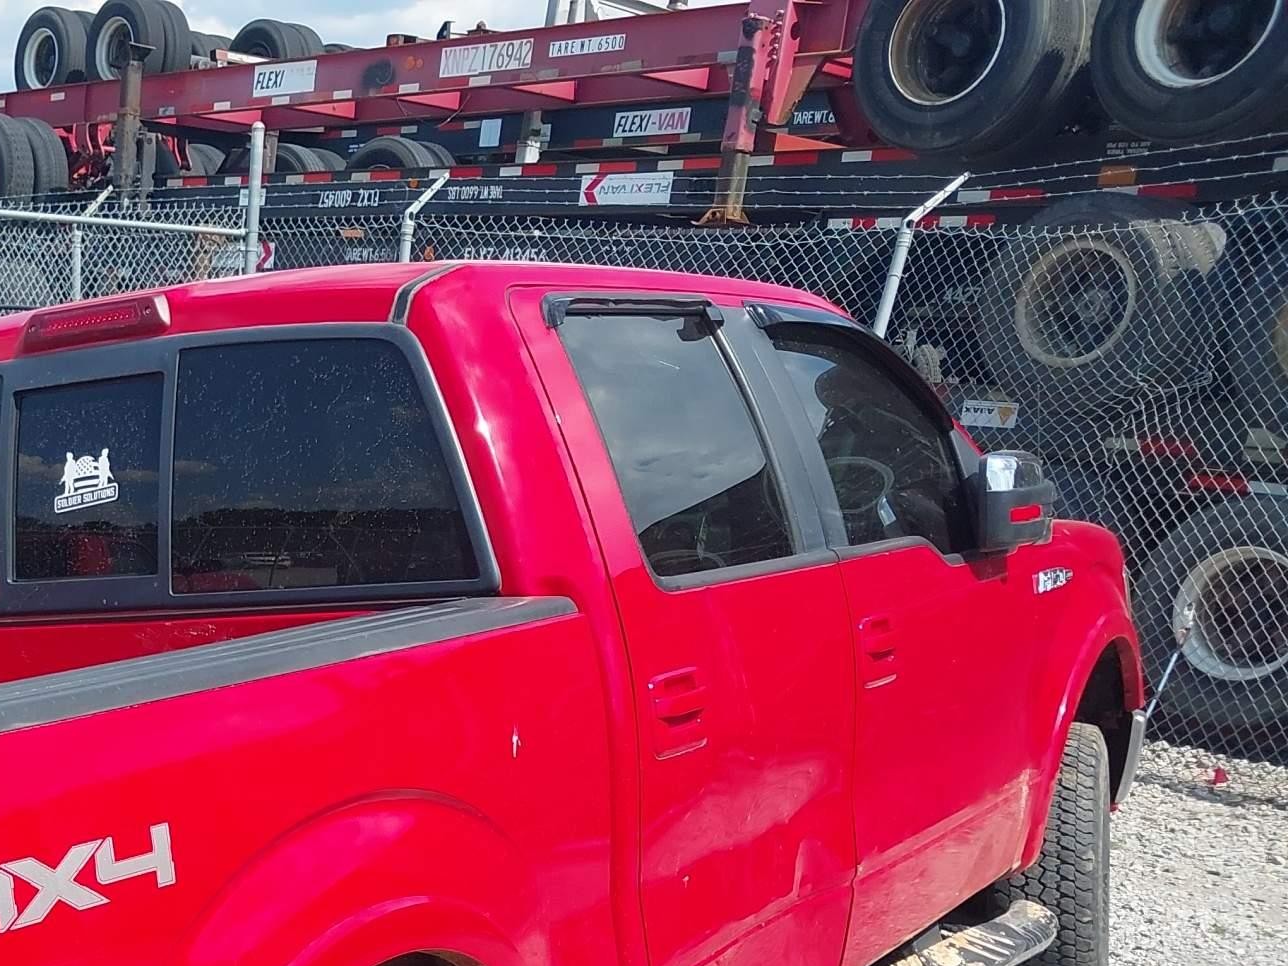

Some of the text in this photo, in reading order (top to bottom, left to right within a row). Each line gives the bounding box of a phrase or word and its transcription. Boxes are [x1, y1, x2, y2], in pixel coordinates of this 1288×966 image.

[551, 41, 575, 56] TARE
[597, 36, 624, 50] 6500
[255, 70, 285, 90] FLEXI
[598, 181, 670, 195] FLEXI VAN
[318, 190, 352, 207] 600457
[57, 486, 115, 509] SOLDIER SOLUTIONS
